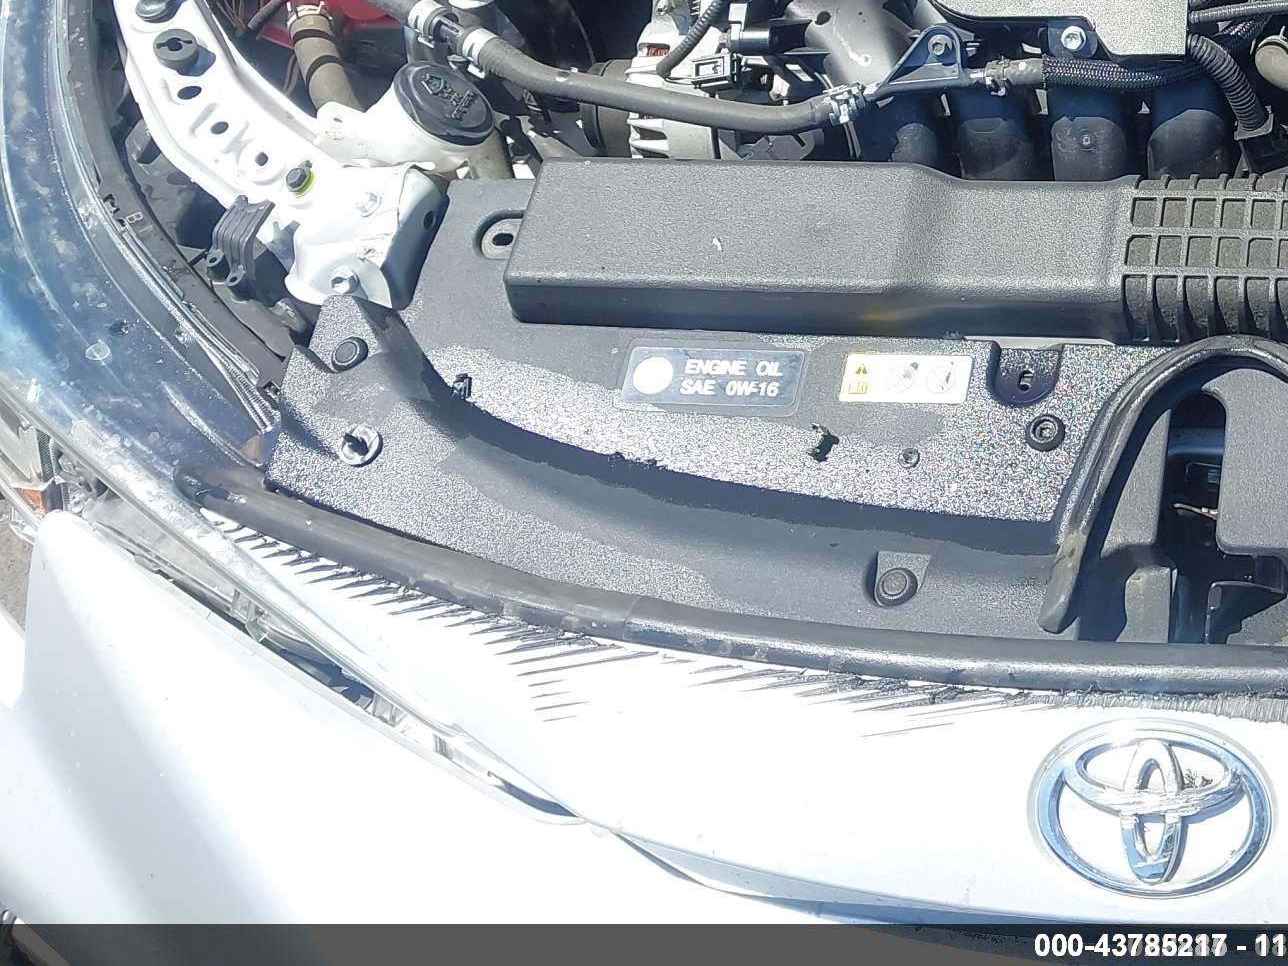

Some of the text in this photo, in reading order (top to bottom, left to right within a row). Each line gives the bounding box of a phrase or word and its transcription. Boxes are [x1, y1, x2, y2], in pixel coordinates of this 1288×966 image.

[684, 358, 784, 377] ENGINE OIL
[679, 379, 780, 397] SAE 0W-16
